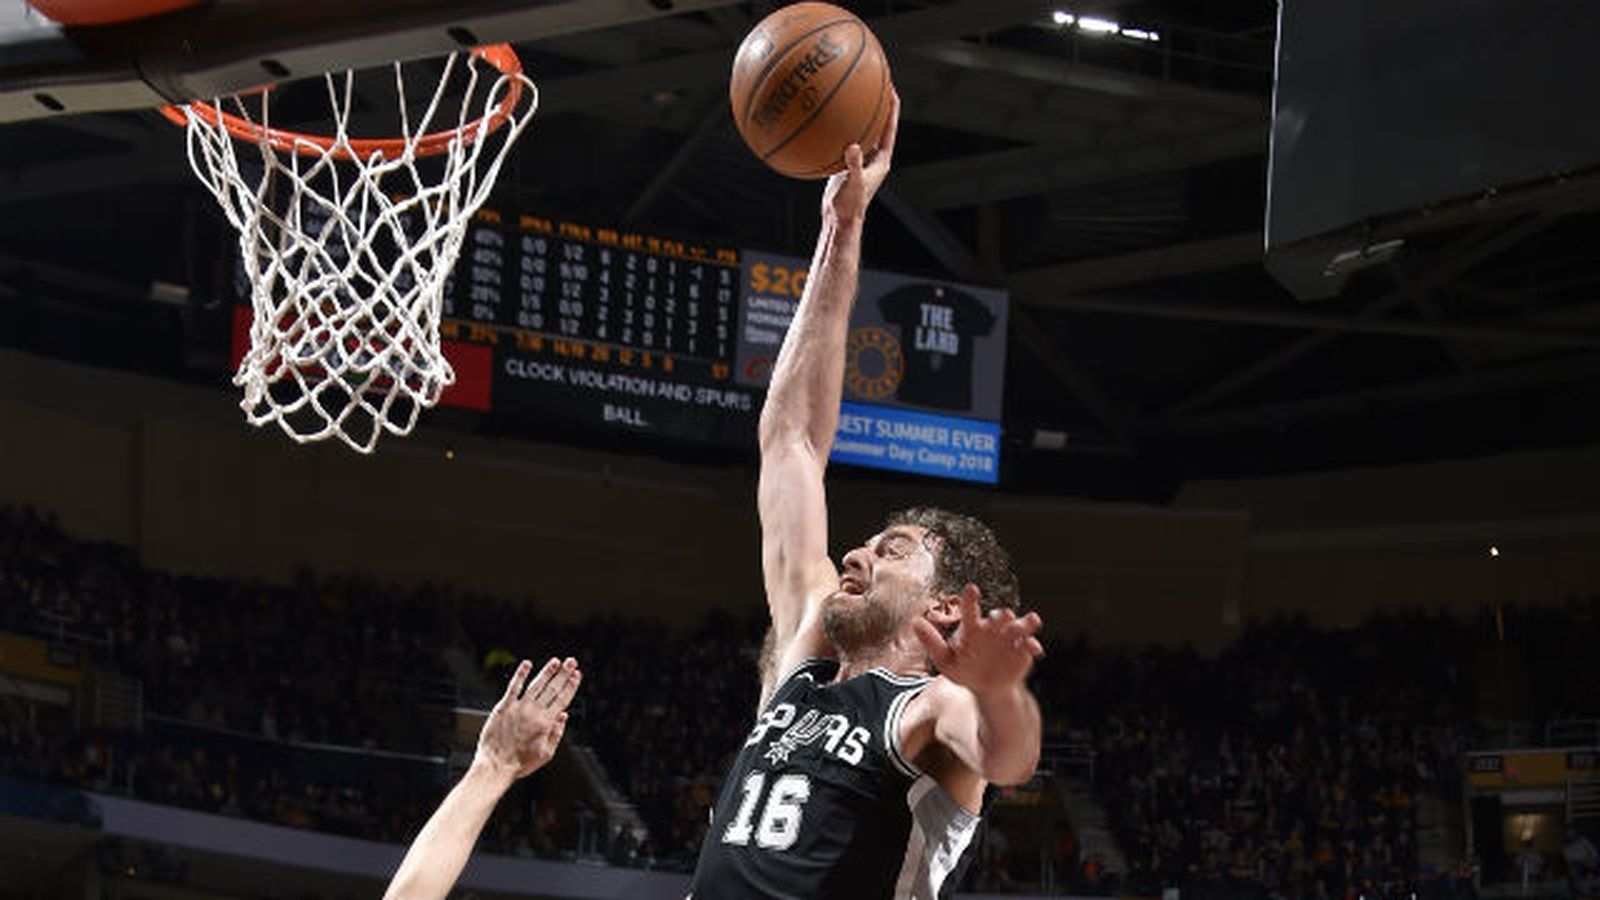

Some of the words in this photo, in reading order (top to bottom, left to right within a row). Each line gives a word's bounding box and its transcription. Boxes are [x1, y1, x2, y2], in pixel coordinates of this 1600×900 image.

[920, 303, 954, 330] THE
[914, 326, 959, 356] LAND
[505, 359, 564, 383] CLOCK
[569, 366, 655, 397] VIOLATION
[658, 382, 691, 402] AND
[695, 386, 751, 410] SPURS
[838, 413, 873, 436] EST
[876, 416, 949, 447] SUMMER
[952, 429, 996, 453] EVER
[888, 443, 915, 465] Day
[918, 447, 957, 471] Camp
[959, 451, 993, 473] 2018
[721, 769, 811, 850] 16
